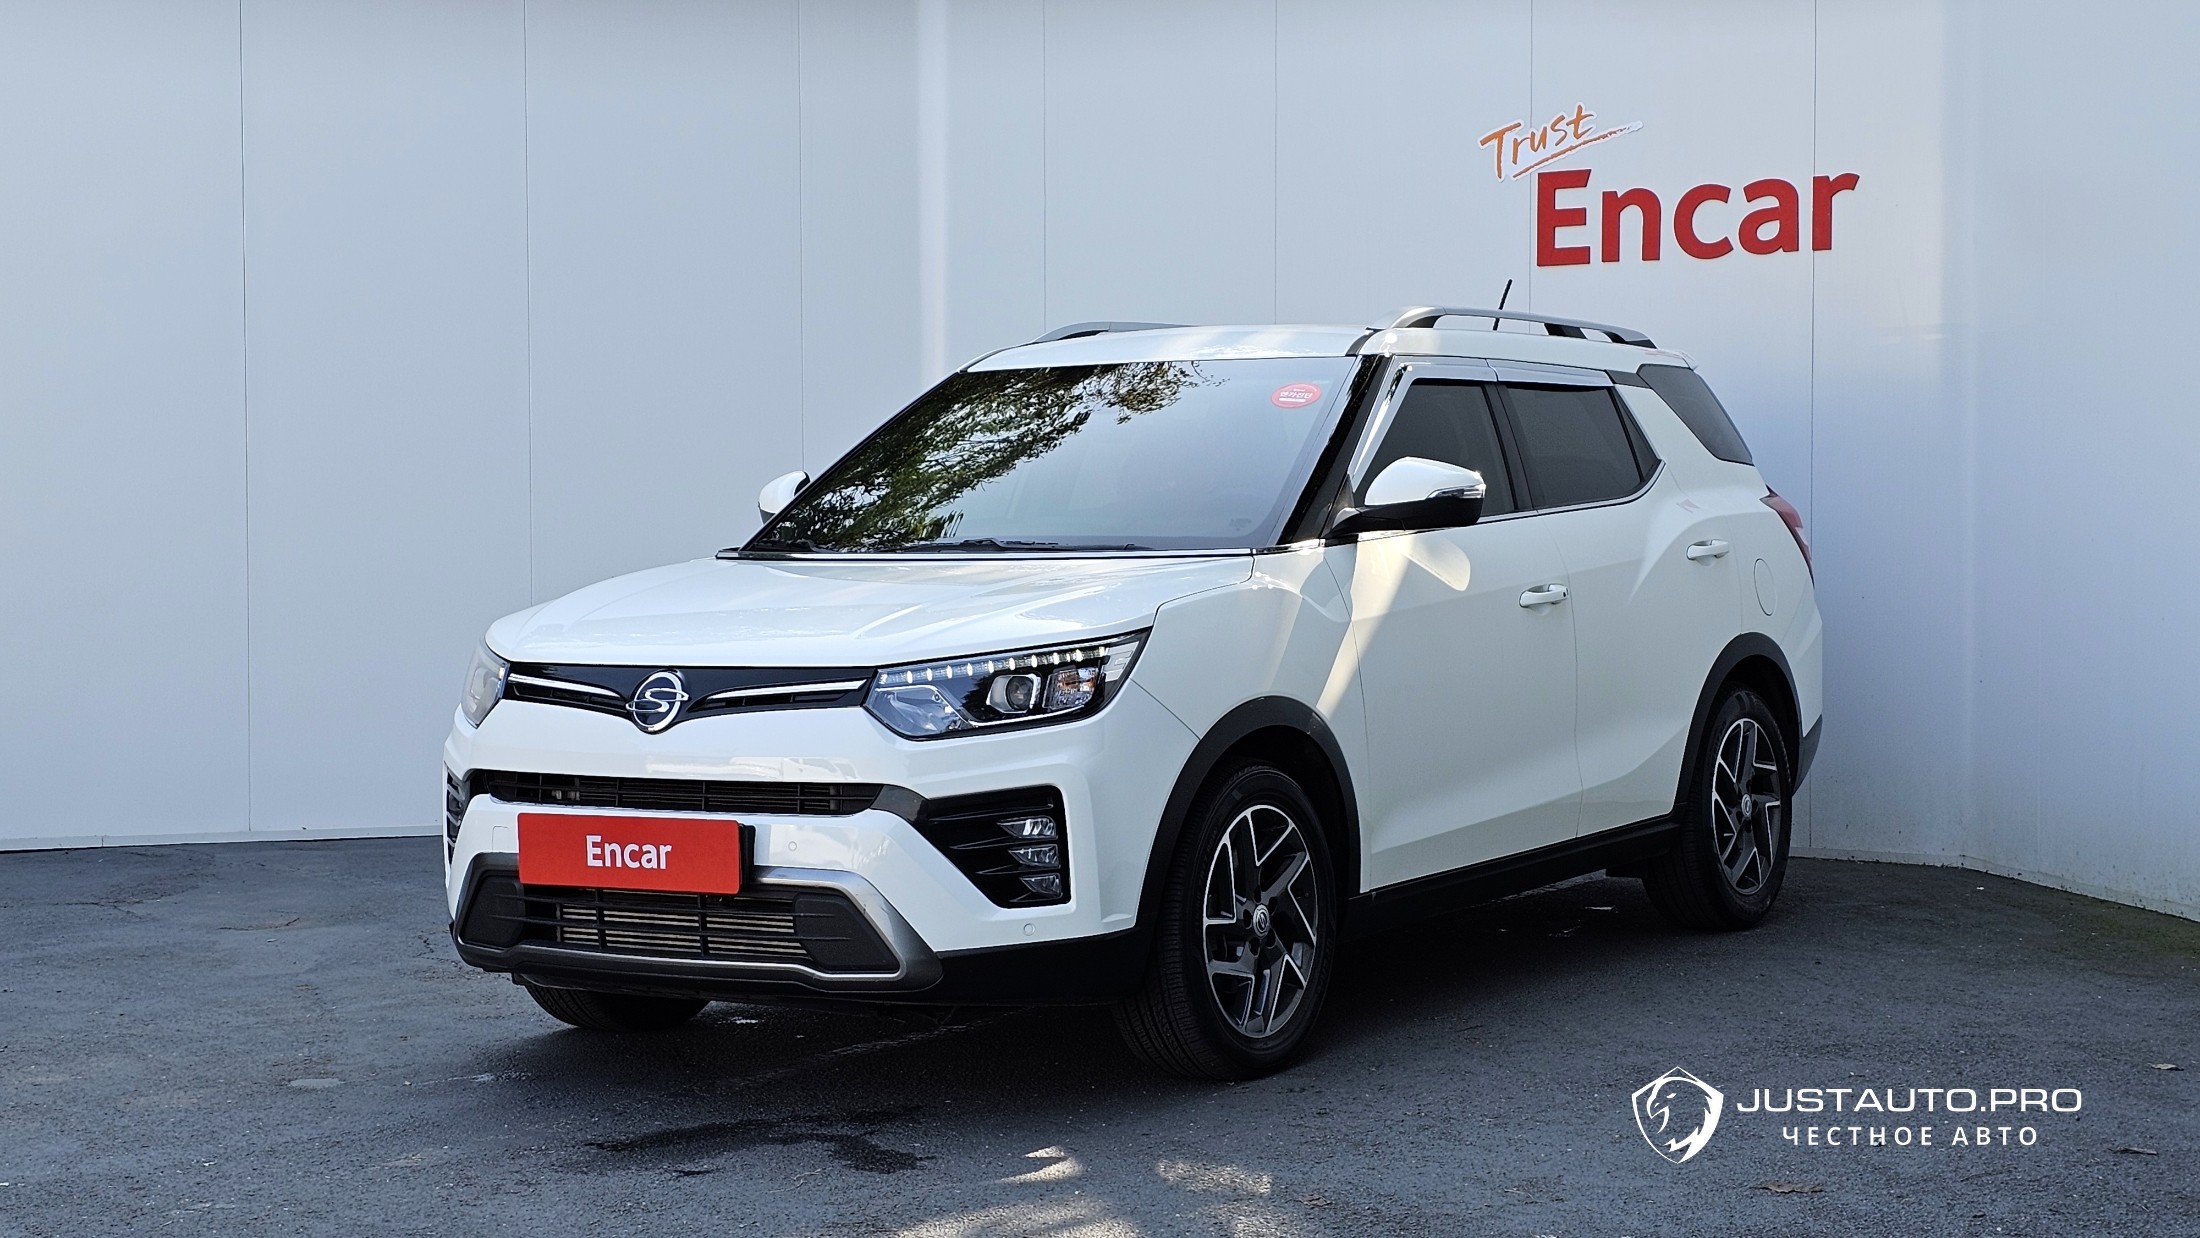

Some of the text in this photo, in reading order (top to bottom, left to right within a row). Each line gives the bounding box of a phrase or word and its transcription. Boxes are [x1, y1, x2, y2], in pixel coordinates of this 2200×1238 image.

[1480, 105, 1595, 180] Trust
[1537, 168, 1860, 267] Encar
[586, 835, 672, 869] Encar
